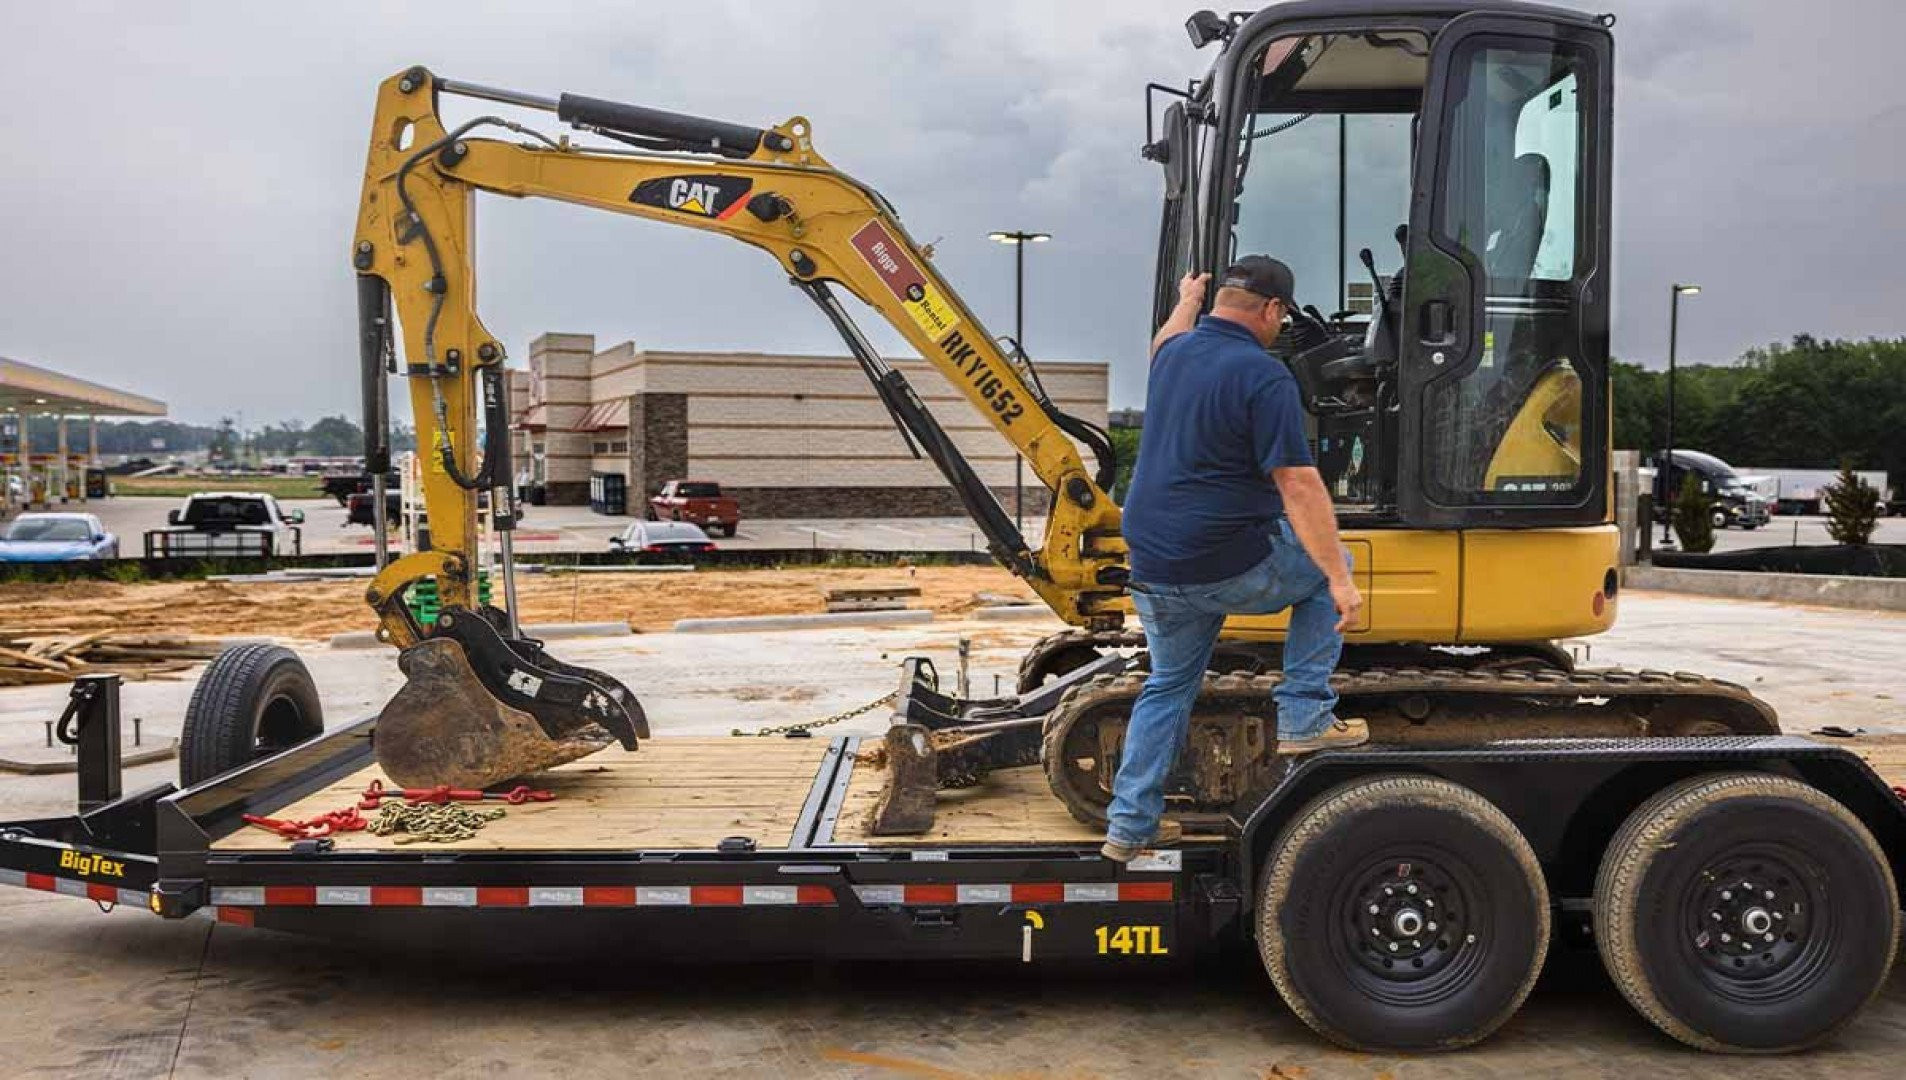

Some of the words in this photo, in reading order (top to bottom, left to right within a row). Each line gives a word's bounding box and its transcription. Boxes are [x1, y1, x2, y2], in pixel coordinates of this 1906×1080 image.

[668, 178, 721, 216] CAT
[871, 241, 900, 273] Riggs
[920, 299, 948, 331] Rental
[940, 329, 1024, 426] RKY1652
[1094, 925, 1168, 954] 14TL
